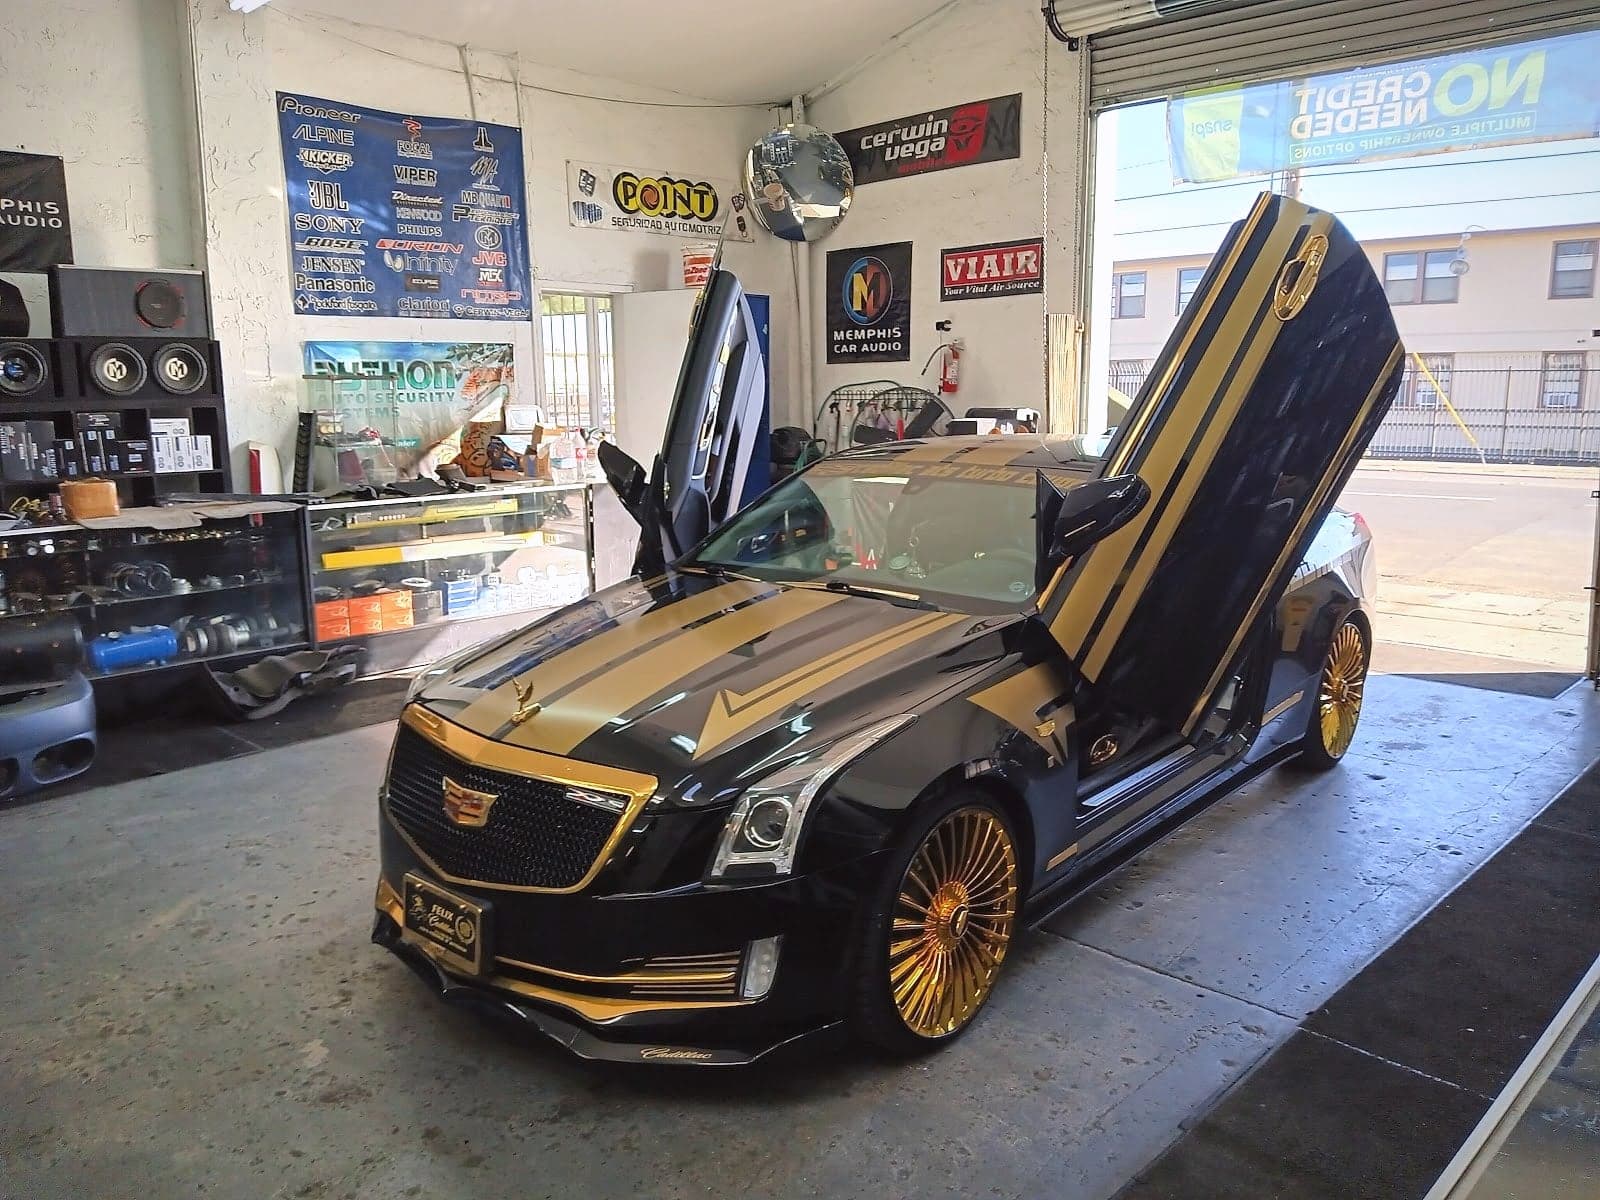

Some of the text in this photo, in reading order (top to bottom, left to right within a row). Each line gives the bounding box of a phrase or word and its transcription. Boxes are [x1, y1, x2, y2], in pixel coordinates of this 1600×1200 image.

[280, 96, 361, 124] Pioneer
[292, 124, 355, 146] ALPINE
[860, 114, 948, 150] cerwin
[884, 136, 946, 161] vega
[305, 149, 352, 167] KICKER
[394, 165, 437, 182] VIPER
[308, 180, 349, 211] JBL
[617, 175, 714, 218] POINT
[0, 198, 60, 214] PHIS
[295, 213, 365, 234] SONY
[397, 223, 443, 237] PHILIPS
[611, 216, 722, 235] SEGURIDAD AUTOMOTRIZ
[304, 236, 367, 251] BOSE
[302, 255, 365, 274] JENSEN
[472, 250, 508, 266] JVC
[946, 250, 1038, 281] VIAIR
[294, 272, 376, 293] Panasonic
[944, 287, 964, 296] Your
[1005, 281, 1040, 290] Source
[398, 296, 450, 311] Clarion
[833, 327, 902, 341] MEMPHIS
[833, 341, 902, 353] CAR AUDIO
[375, 391, 456, 404] SECURITY
[342, 407, 401, 419] STEMS
[431, 904, 455, 921] FELIX
[640, 1047, 712, 1059] Cadillac
